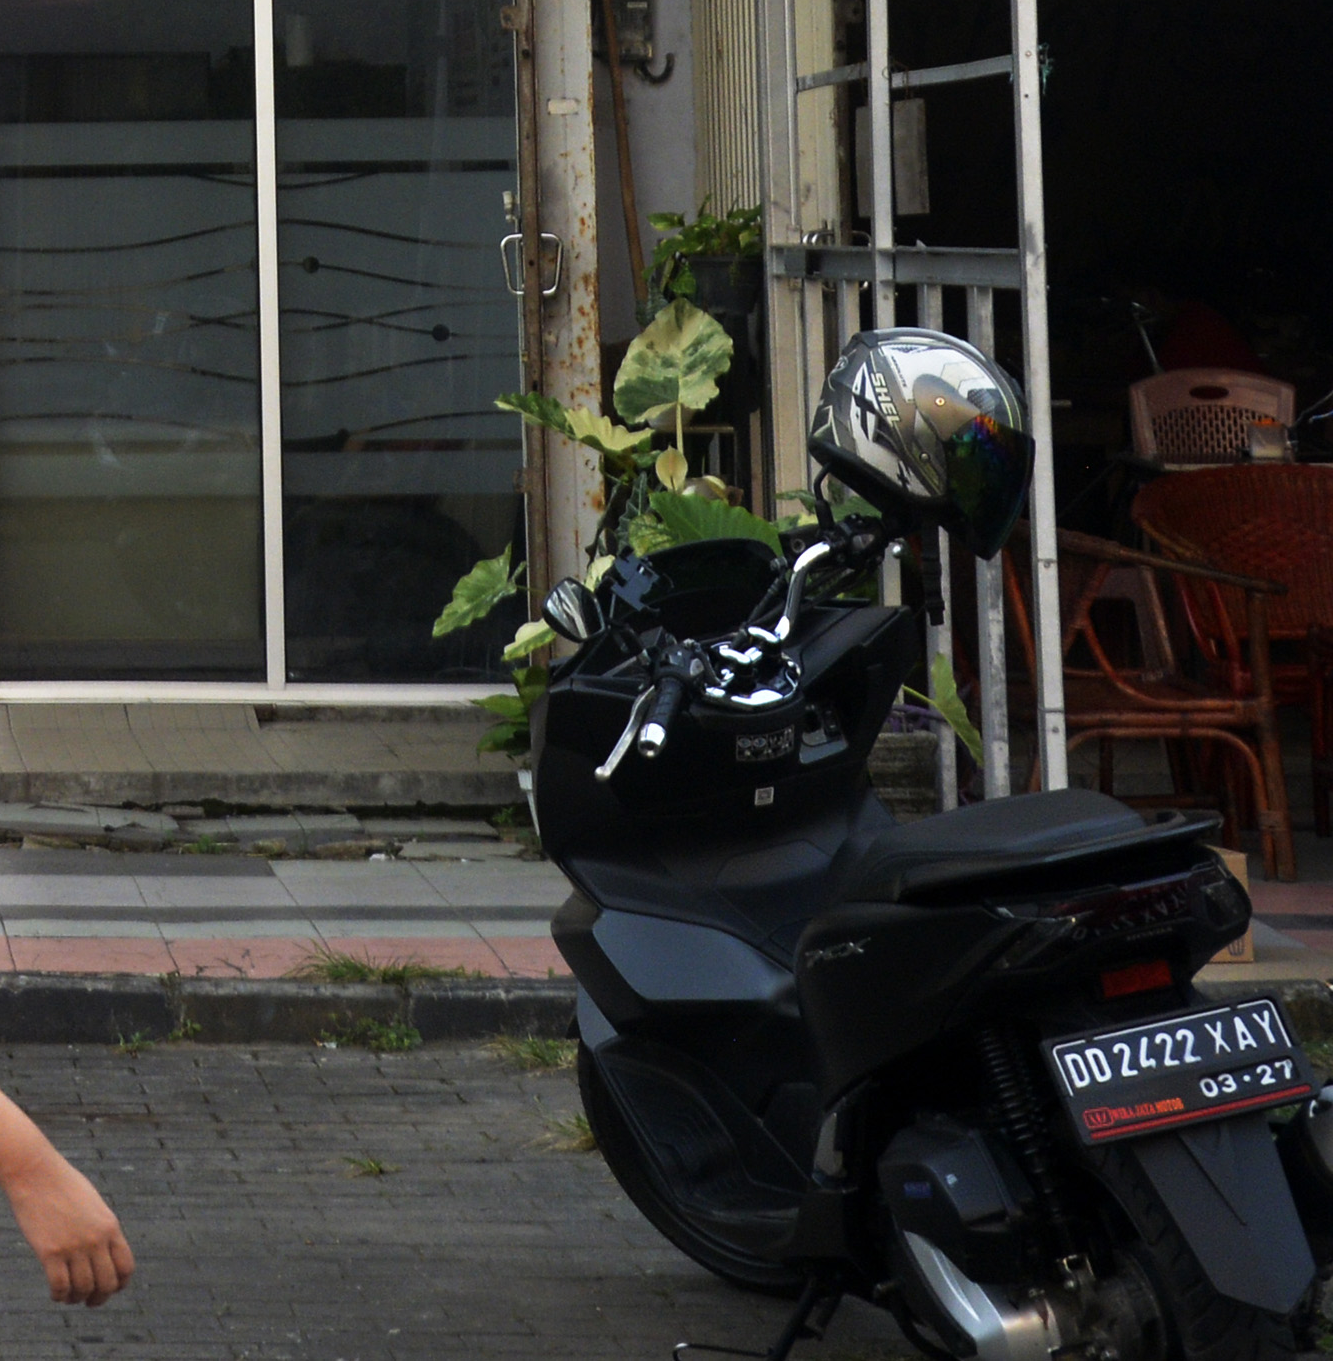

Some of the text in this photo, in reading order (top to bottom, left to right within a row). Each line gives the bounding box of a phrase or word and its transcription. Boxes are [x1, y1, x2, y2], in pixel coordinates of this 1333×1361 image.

[1064, 1010, 1276, 1088] DD 2422 XAY
